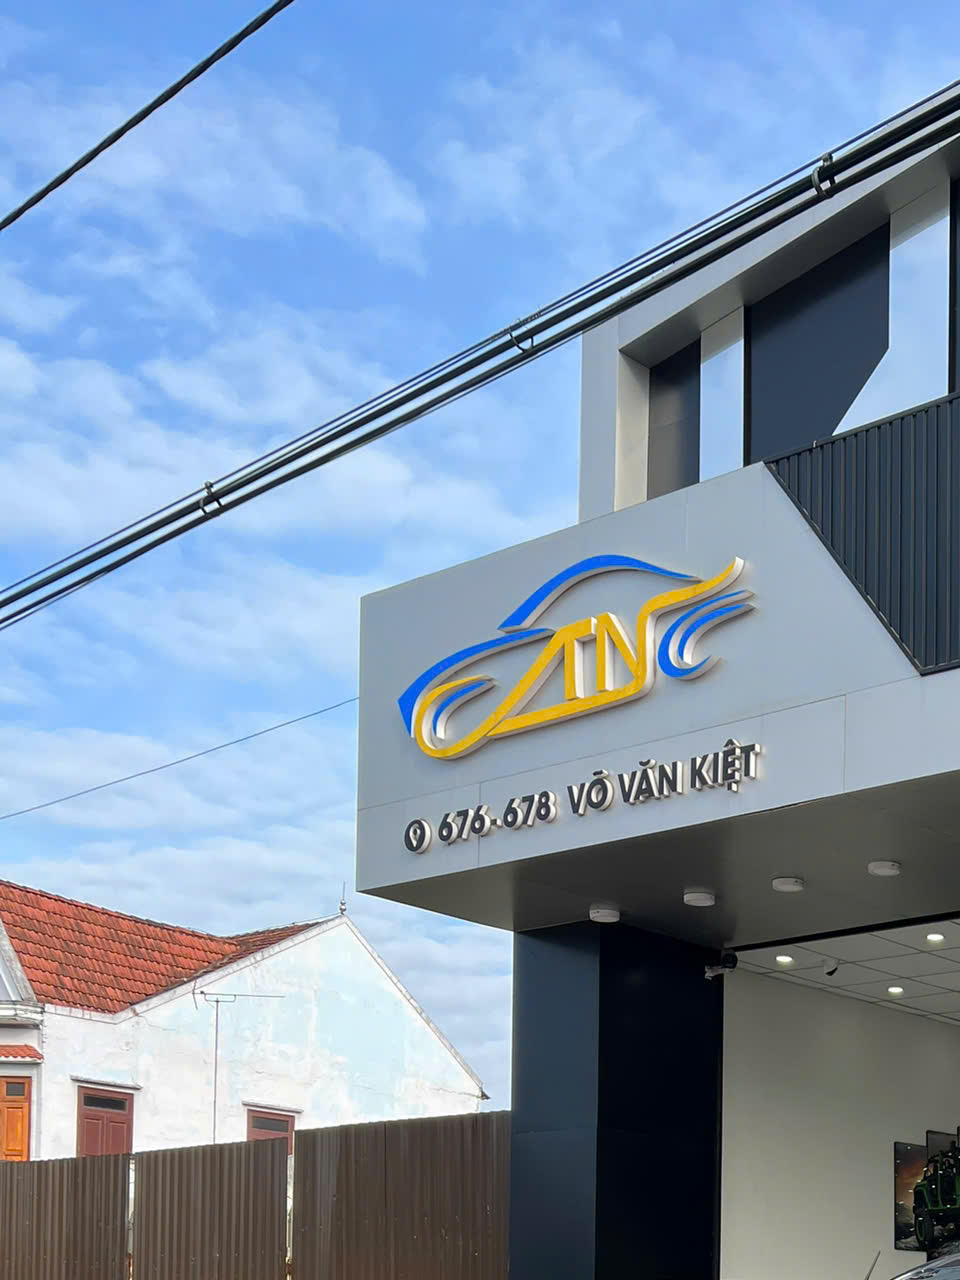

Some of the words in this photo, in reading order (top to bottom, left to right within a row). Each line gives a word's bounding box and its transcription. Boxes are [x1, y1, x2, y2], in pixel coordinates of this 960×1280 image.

[567, 768, 614, 818] VÕ
[618, 758, 686, 806] VĂN
[690, 738, 763, 794] KIỆT
